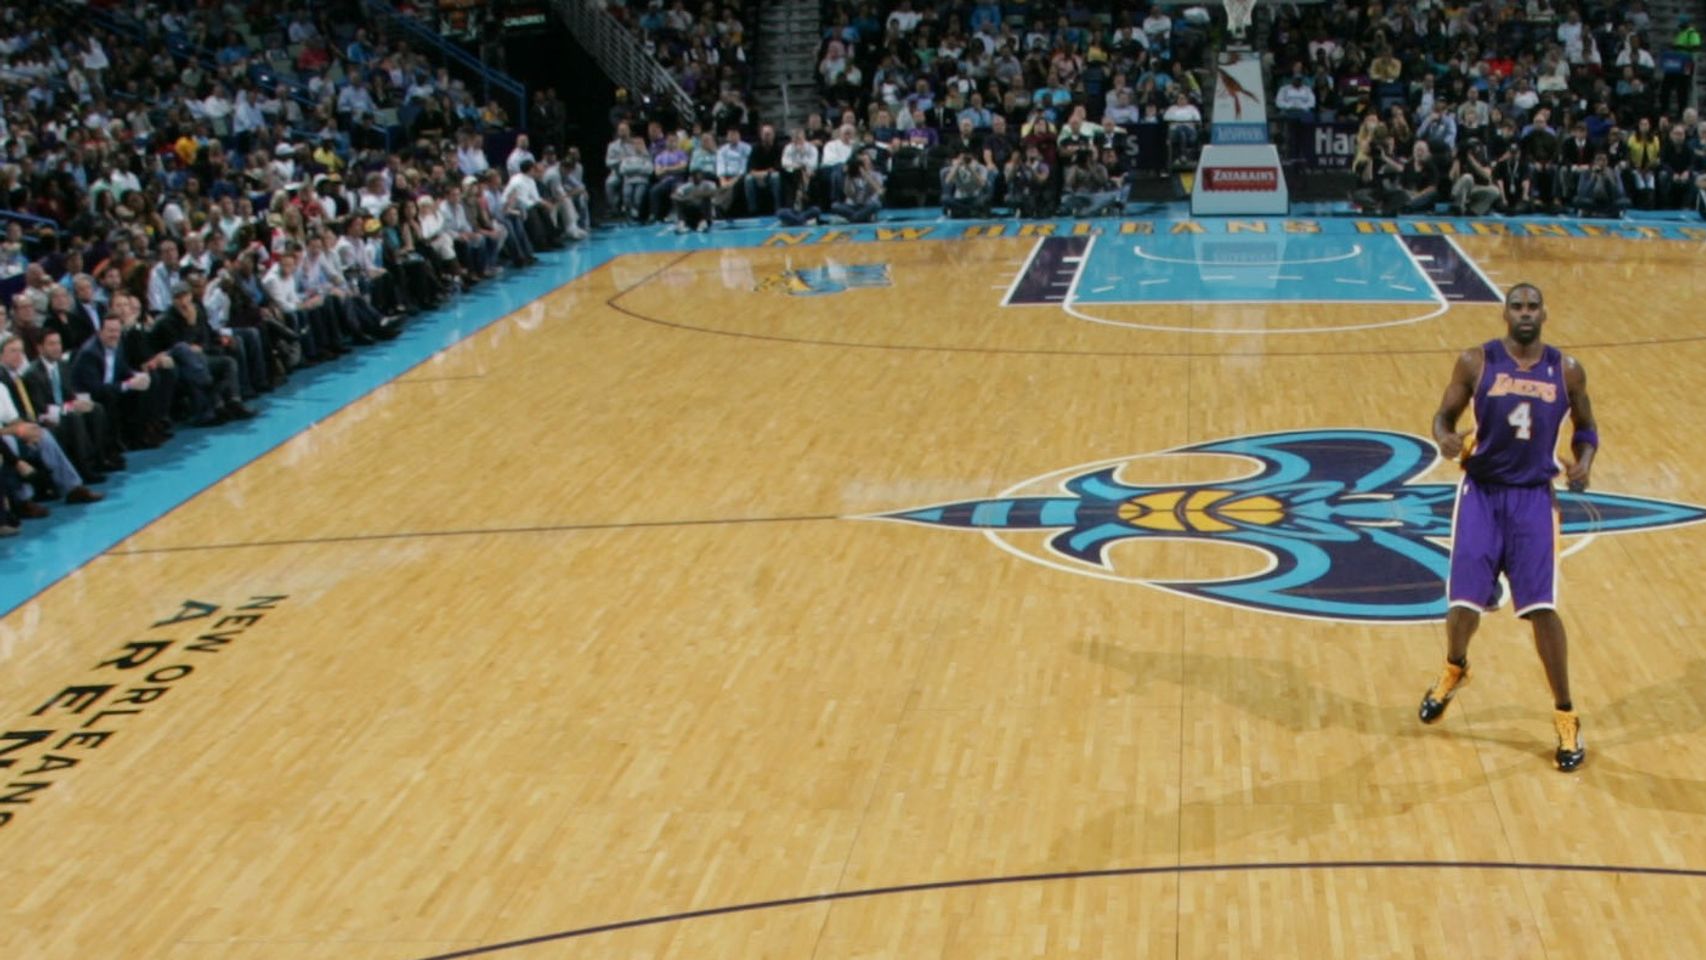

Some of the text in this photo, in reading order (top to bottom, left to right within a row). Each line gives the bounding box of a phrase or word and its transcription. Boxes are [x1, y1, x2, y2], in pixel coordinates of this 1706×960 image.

[962, 219, 1322, 239] ORLEANS
[1487, 373, 1557, 403] LAKERS
[1508, 402, 1532, 440] 4
[183, 595, 290, 653] NEW
